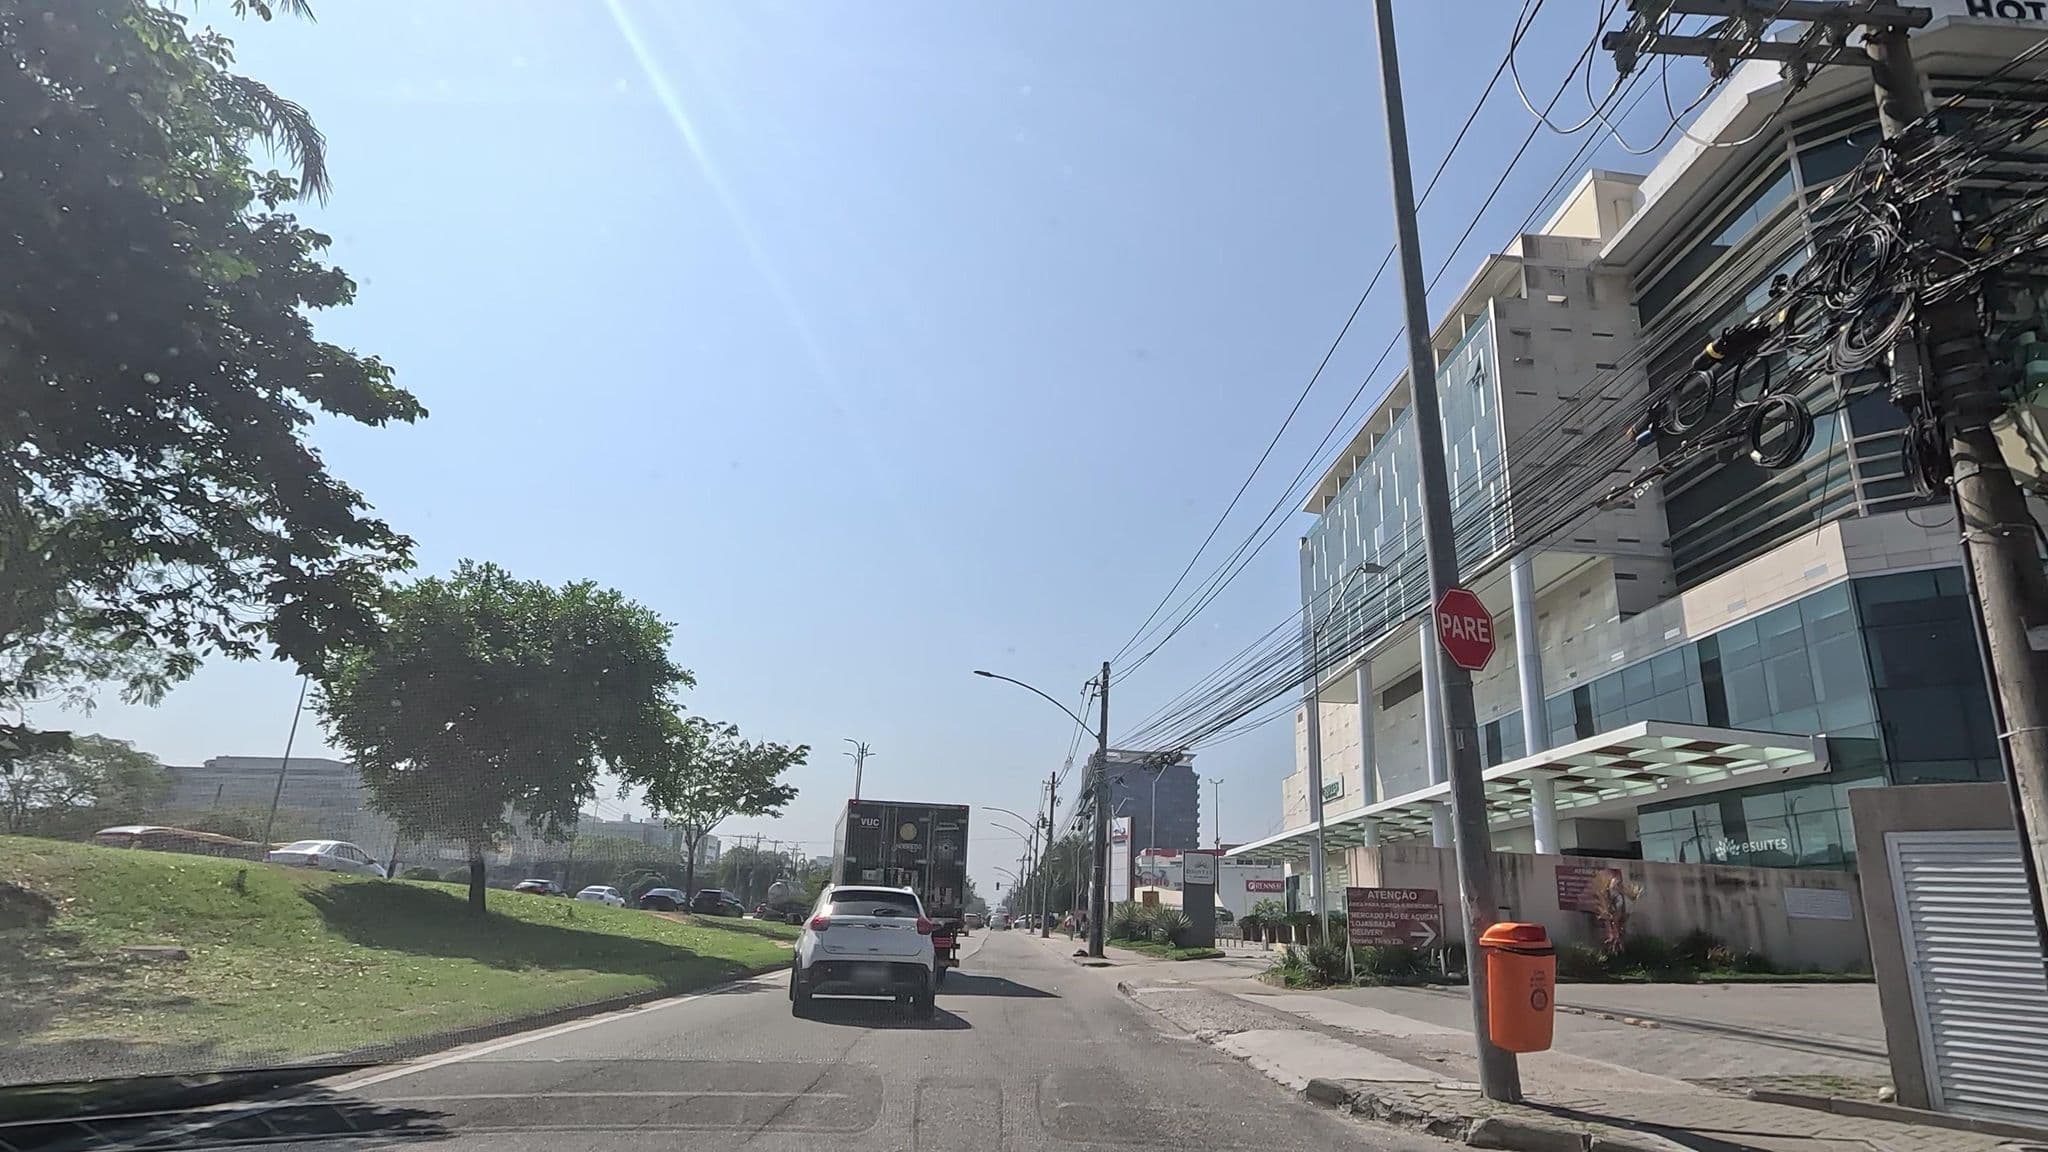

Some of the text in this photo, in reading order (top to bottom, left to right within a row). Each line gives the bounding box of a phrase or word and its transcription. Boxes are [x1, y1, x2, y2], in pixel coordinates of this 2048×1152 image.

[1439, 612, 1491, 643] PARE
[860, 817, 880, 827] VUC
[1367, 889, 1418, 901] ATENÇÃO
